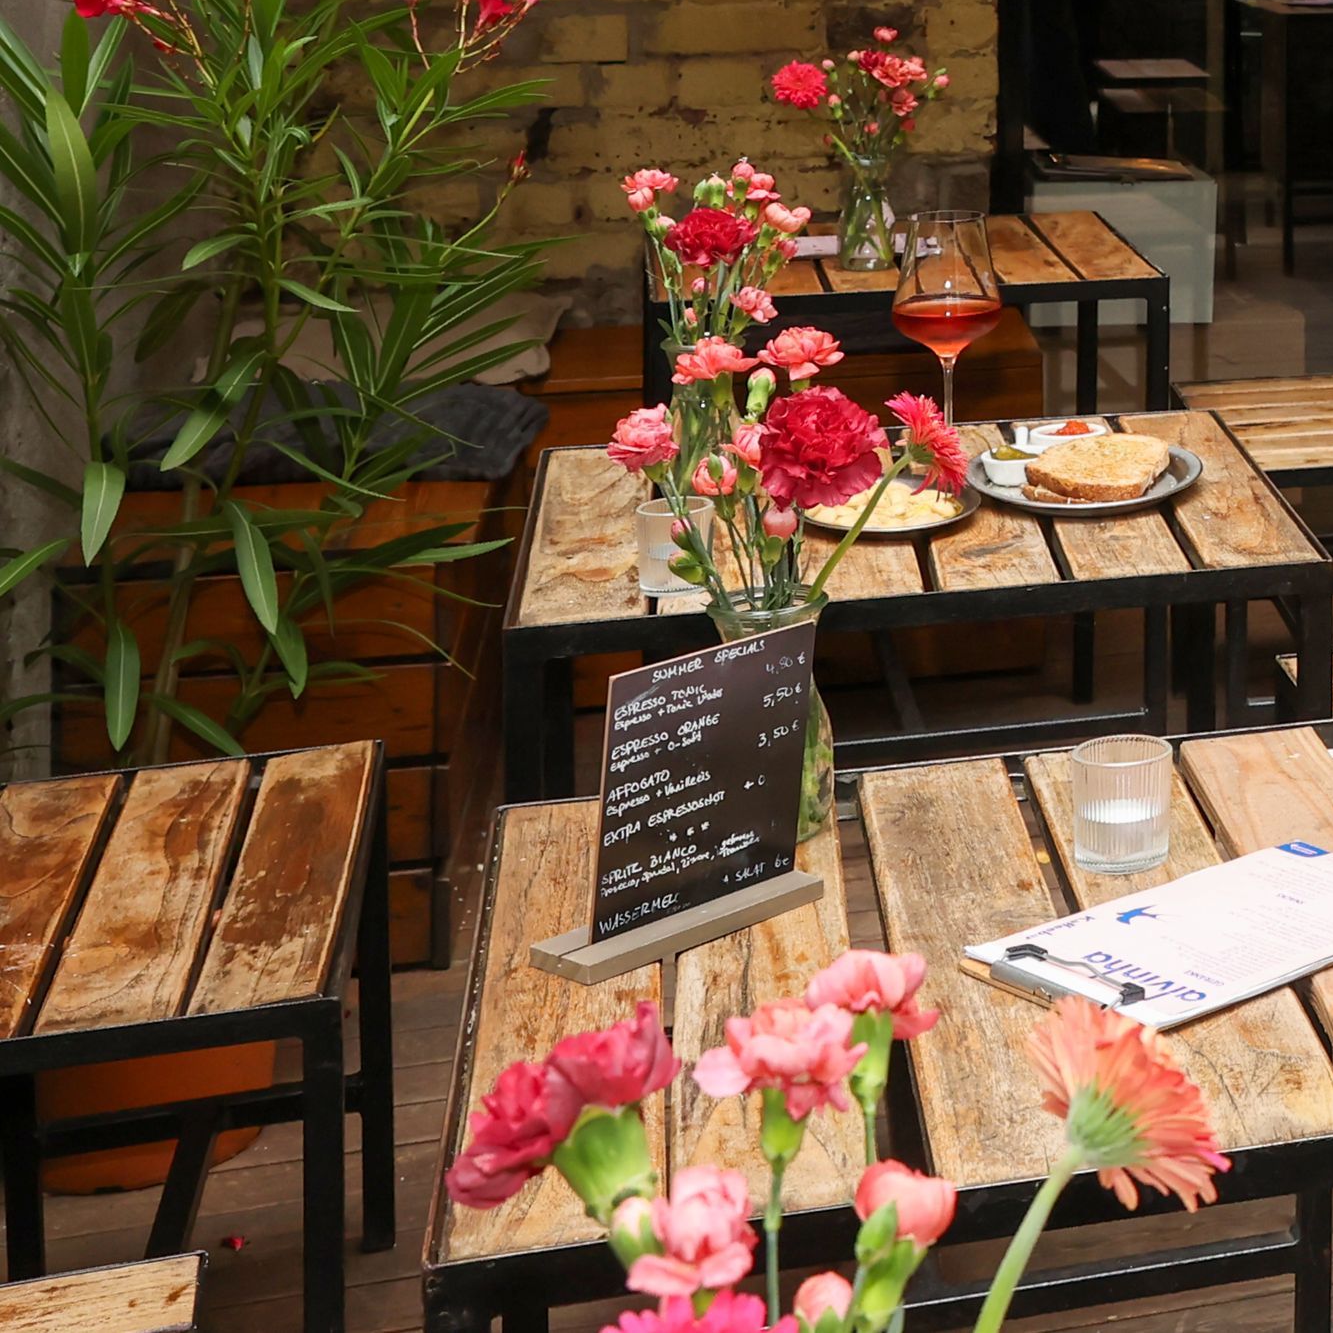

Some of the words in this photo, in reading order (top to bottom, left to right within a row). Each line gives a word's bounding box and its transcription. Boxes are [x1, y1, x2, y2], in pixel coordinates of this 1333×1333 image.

[652, 658, 704, 683] SUMMER
[715, 640, 765, 663] SPECIALS
[614, 696, 666, 721] ESPRESSO
[671, 685, 706, 700] TONIC
[612, 732, 670, 760] ESPRESSO
[678, 714, 720, 735] ORANGE
[607, 770, 671, 803] AFFOGATO
[604, 821, 640, 846] EXTRA
[648, 791, 724, 827] ESPRESSOSHOT
[602, 862, 642, 884] SPRITZ
[650, 845, 696, 868] BIANCO
[736, 863, 766, 881] SALAT
[1083, 951, 1206, 1002] alvinha
